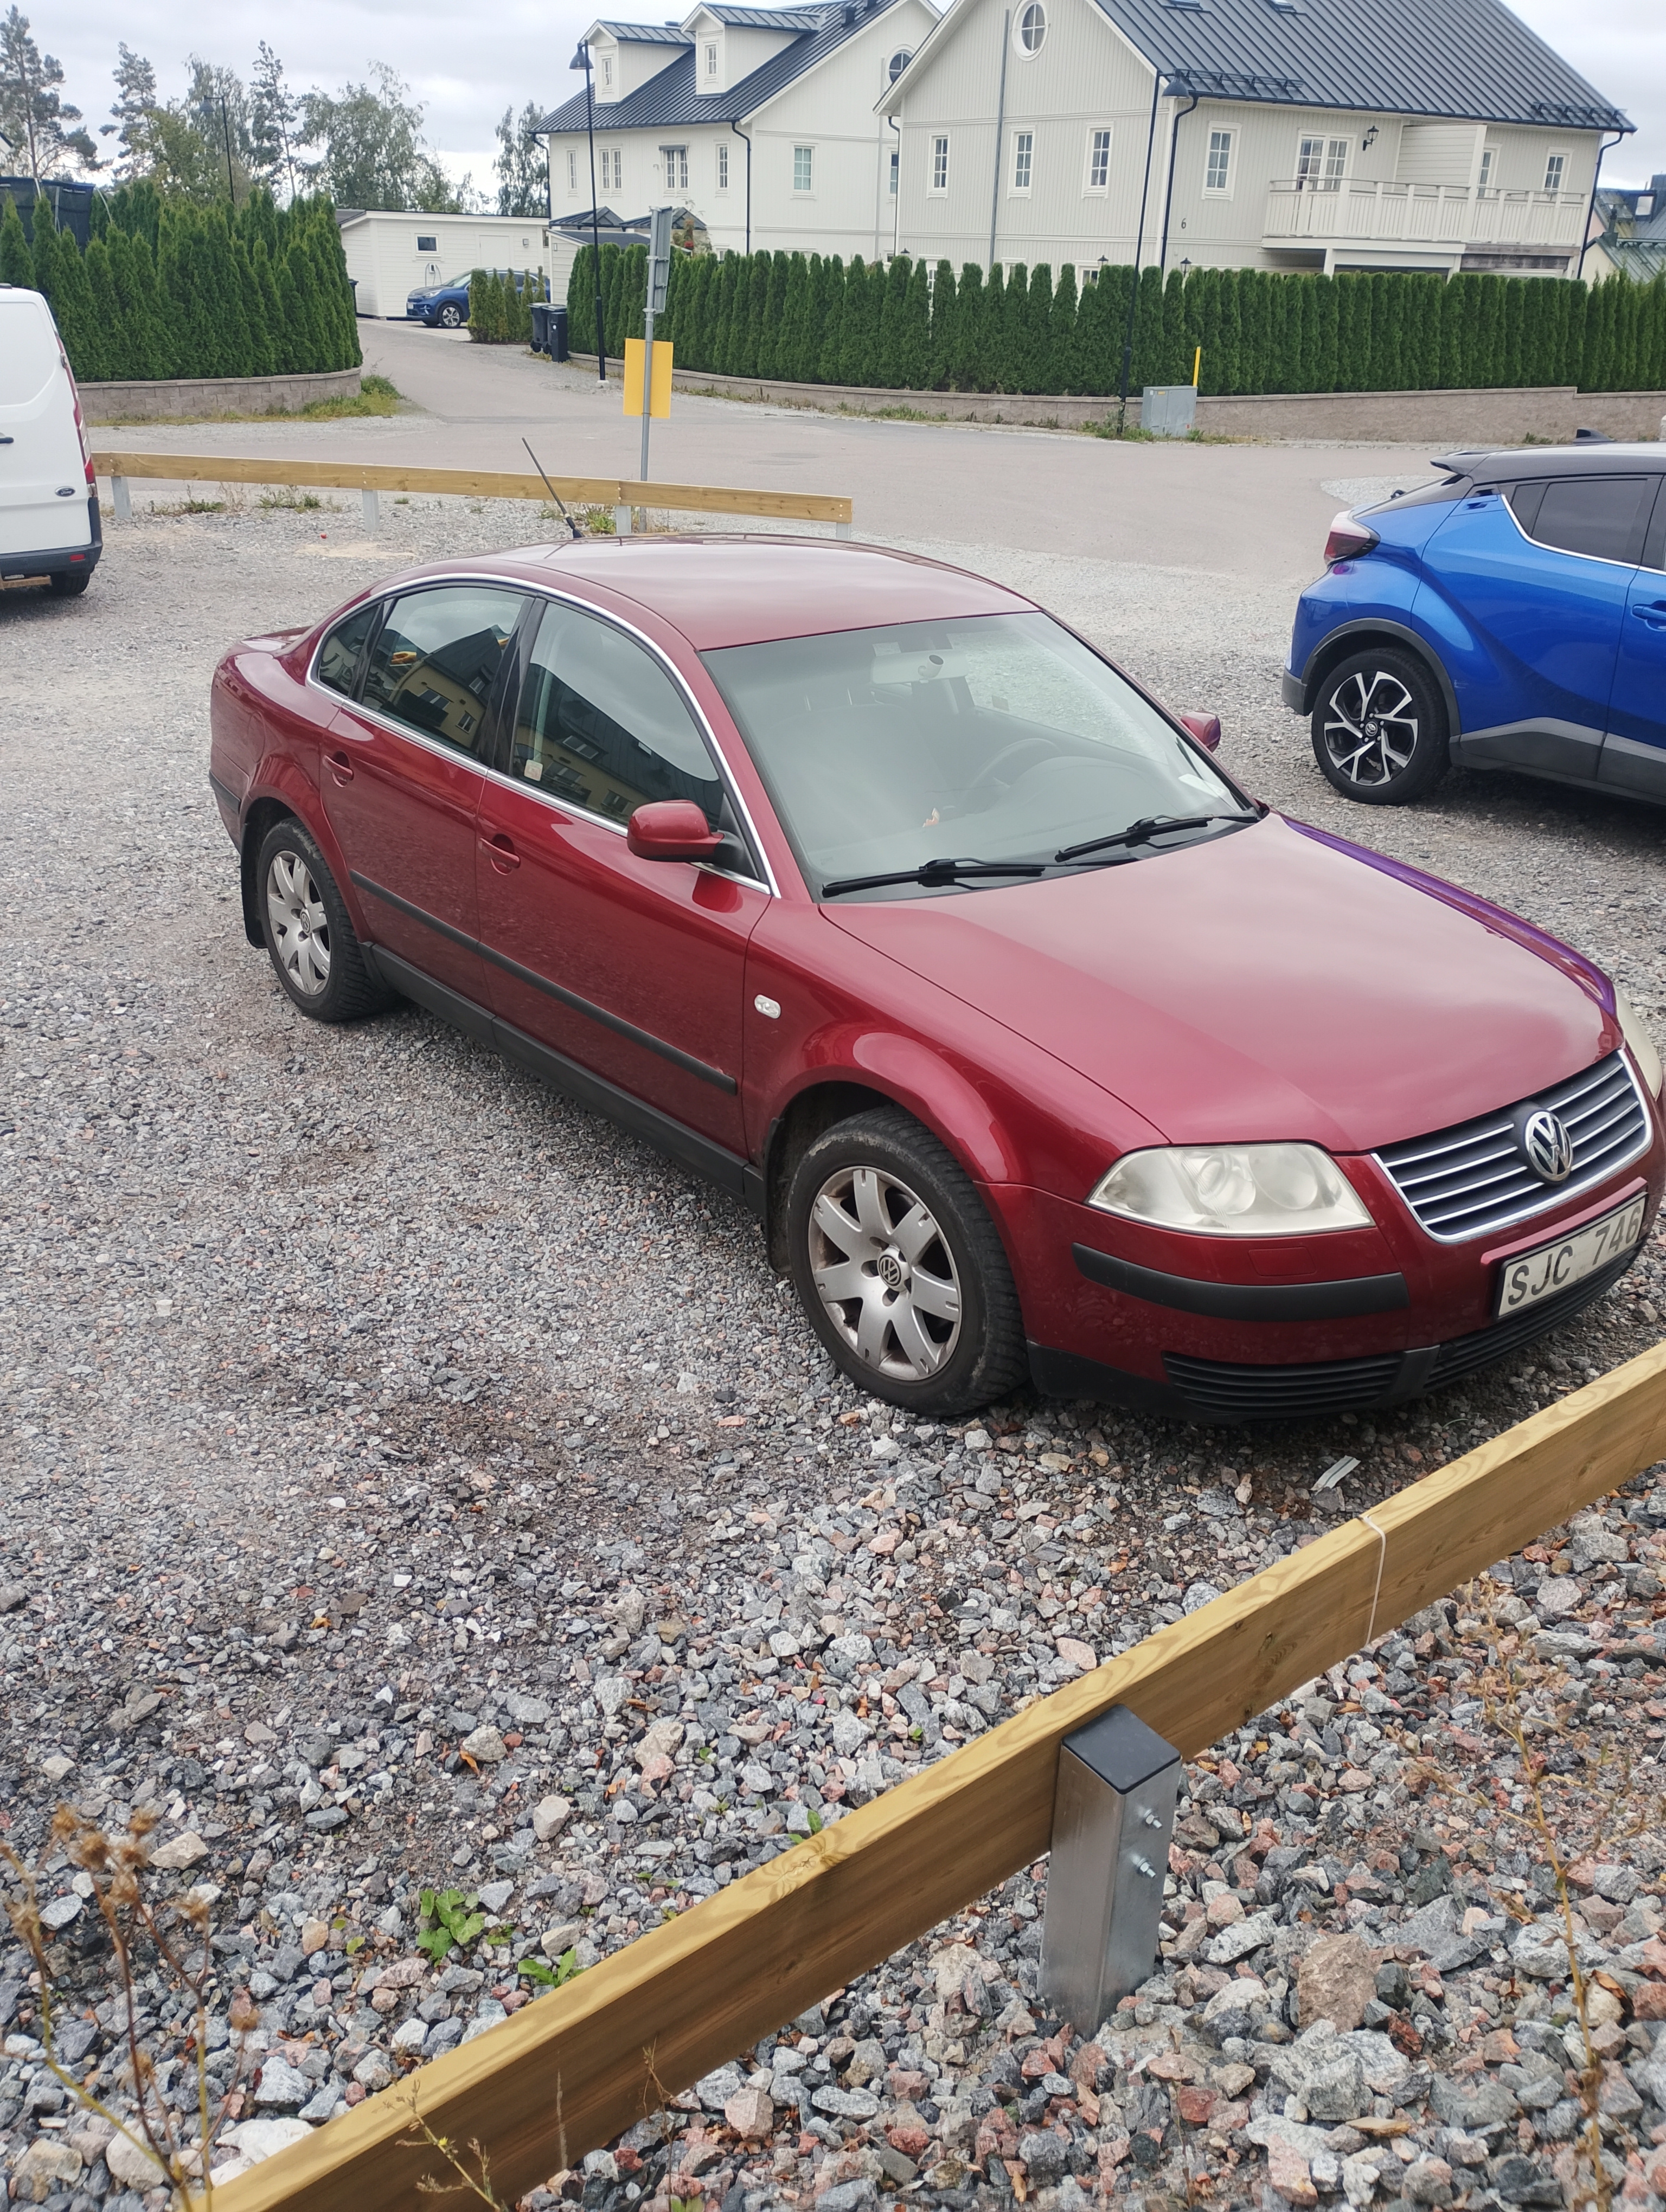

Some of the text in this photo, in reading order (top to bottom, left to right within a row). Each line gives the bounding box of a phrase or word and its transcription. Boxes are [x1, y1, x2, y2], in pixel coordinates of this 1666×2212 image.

[1181, 218, 1186, 229] 6
[1508, 1205, 1641, 1306] SJC 746
